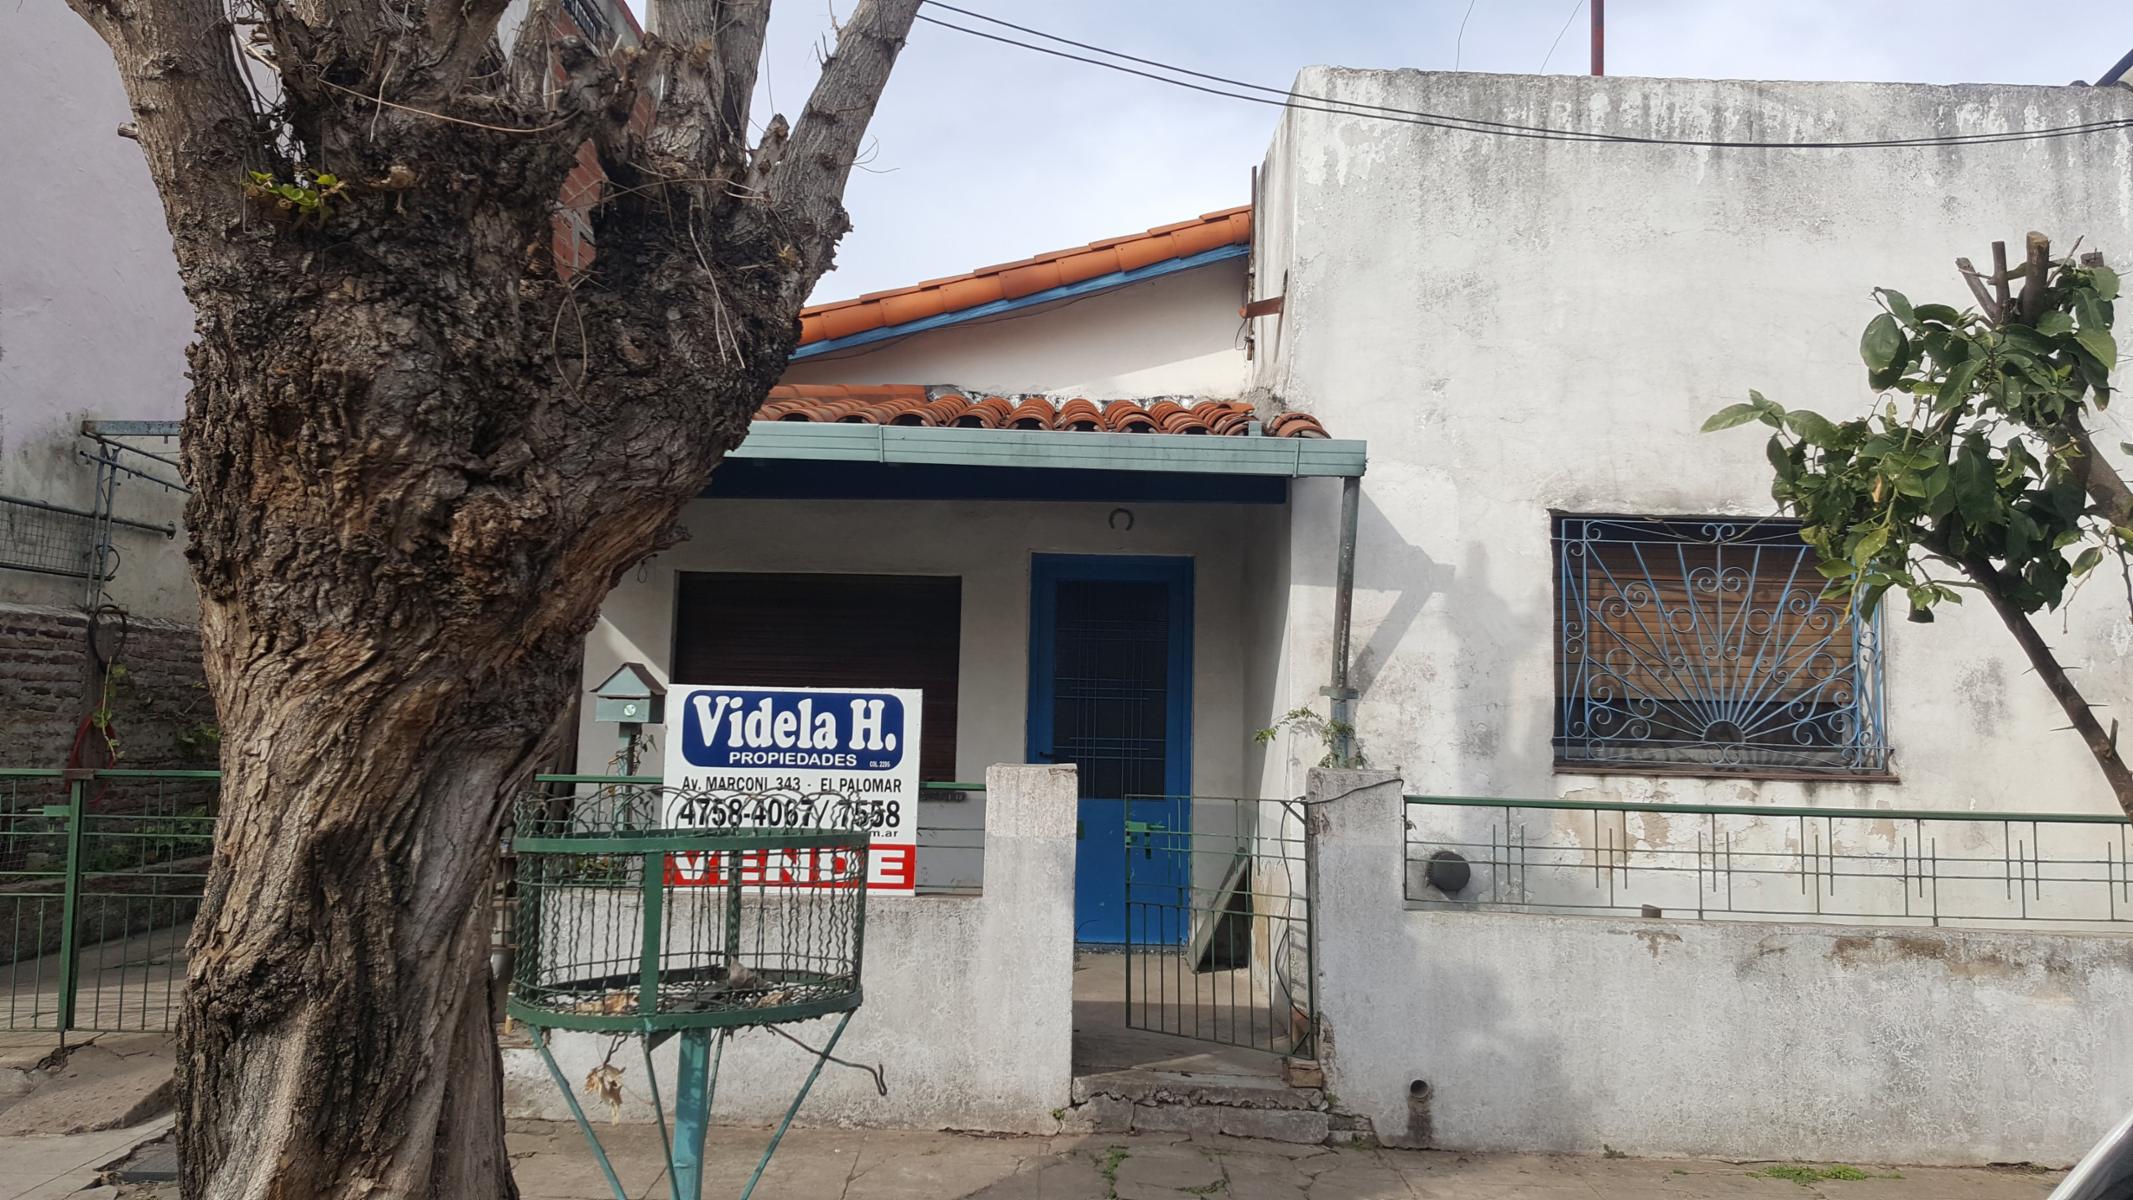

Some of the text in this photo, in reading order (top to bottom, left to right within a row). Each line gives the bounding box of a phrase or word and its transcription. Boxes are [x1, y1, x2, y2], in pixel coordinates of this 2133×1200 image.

[693, 695, 897, 751] Videla H.
[729, 752, 857, 767] PROPIEDADES
[706, 776, 767, 792] MARCONI
[776, 776, 801, 792] 343
[840, 778, 902, 793] PALOMAR
[674, 849, 905, 883] VENDE
